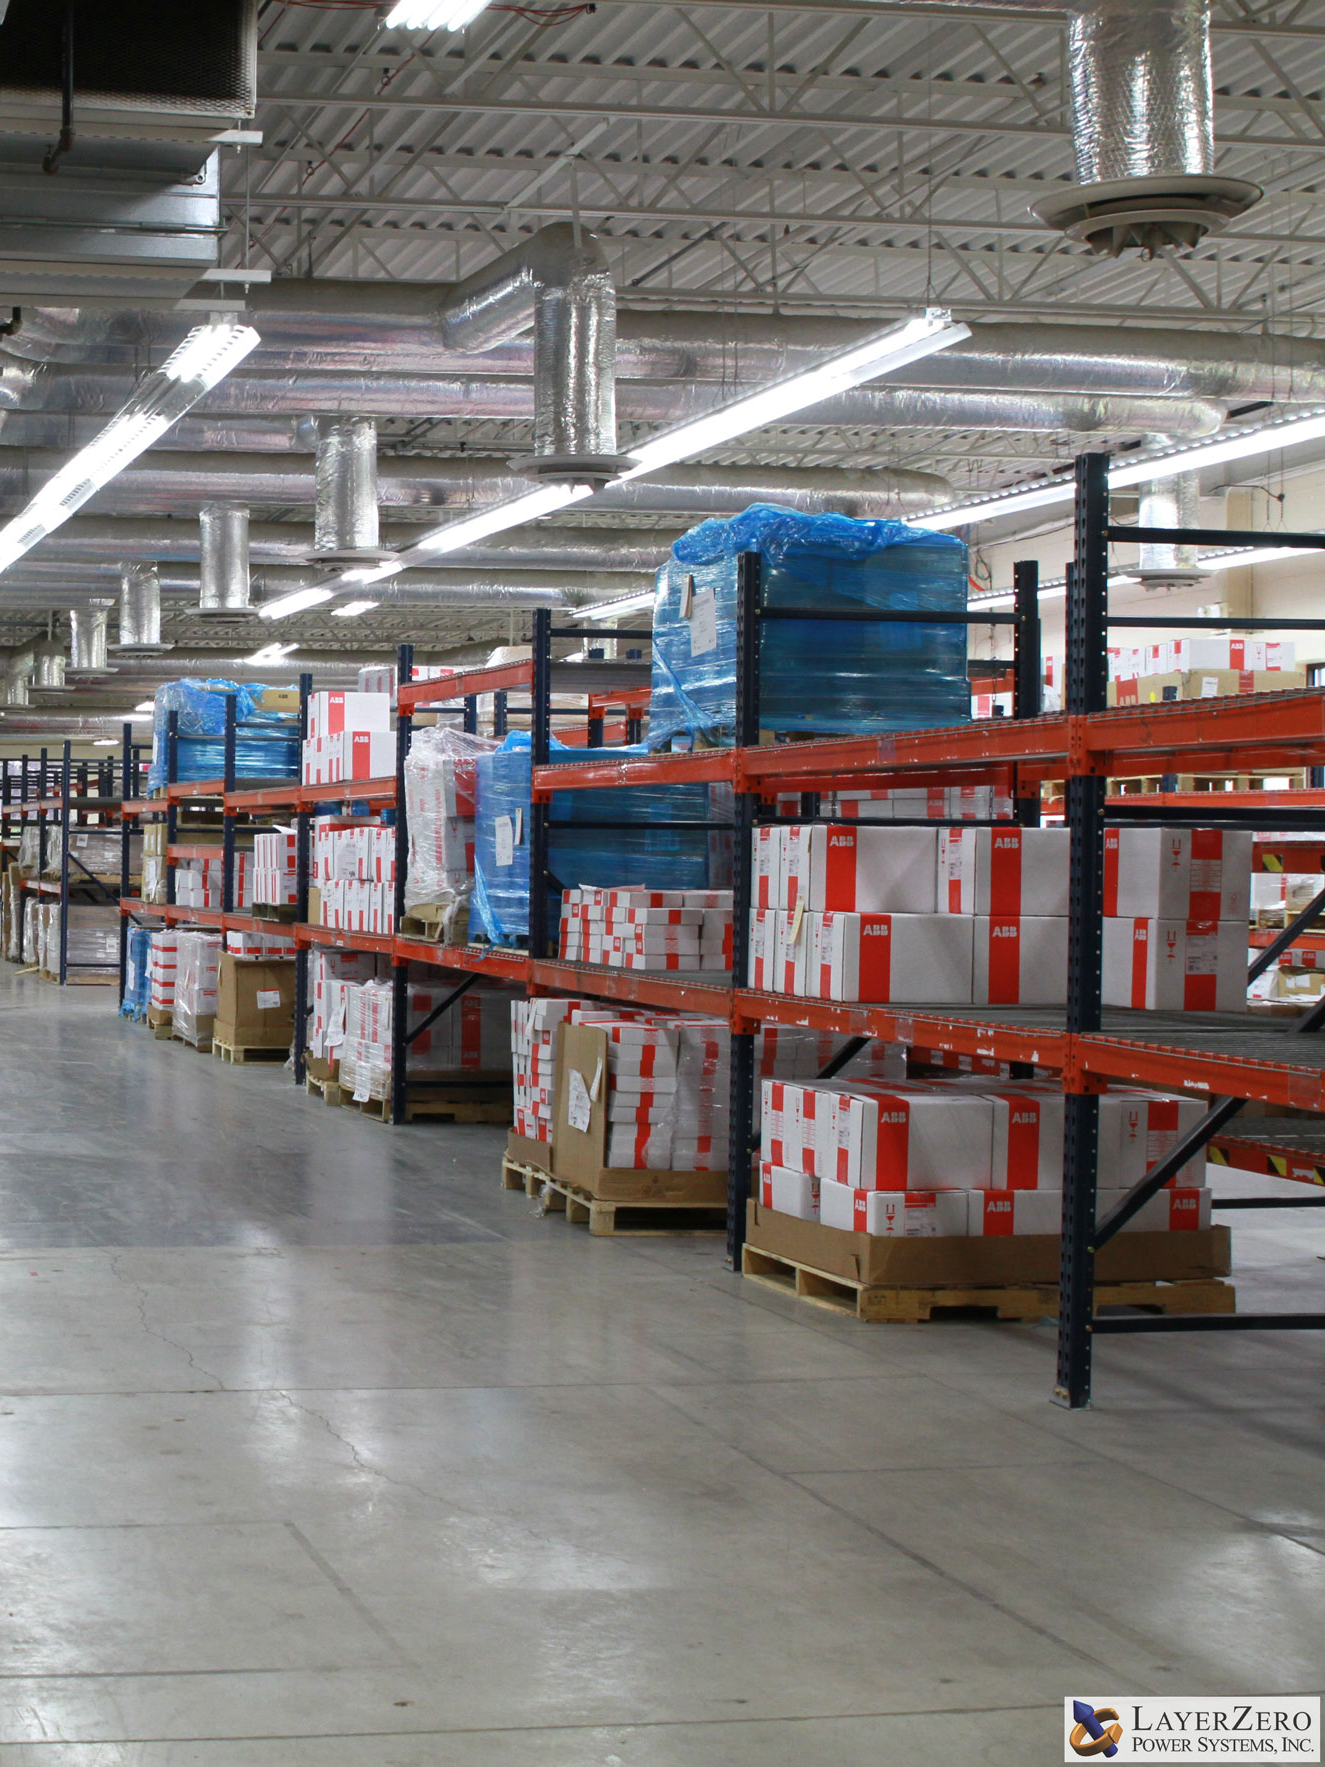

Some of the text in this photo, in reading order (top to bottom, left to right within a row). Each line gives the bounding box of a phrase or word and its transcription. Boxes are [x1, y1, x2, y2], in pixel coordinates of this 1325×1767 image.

[829, 835, 854, 847] ABB
[994, 837, 1019, 849] ABB
[1106, 838, 1118, 849] ABB
[863, 925, 888, 936] ABB
[992, 926, 1018, 938] ABB
[1134, 929, 1147, 941] ABB
[881, 1111, 907, 1123] ABB
[1012, 1112, 1037, 1124] ABB
[855, 1199, 866, 1212] ABB
[987, 1200, 1011, 1212] ABB
[1173, 1198, 1196, 1210] ABB
